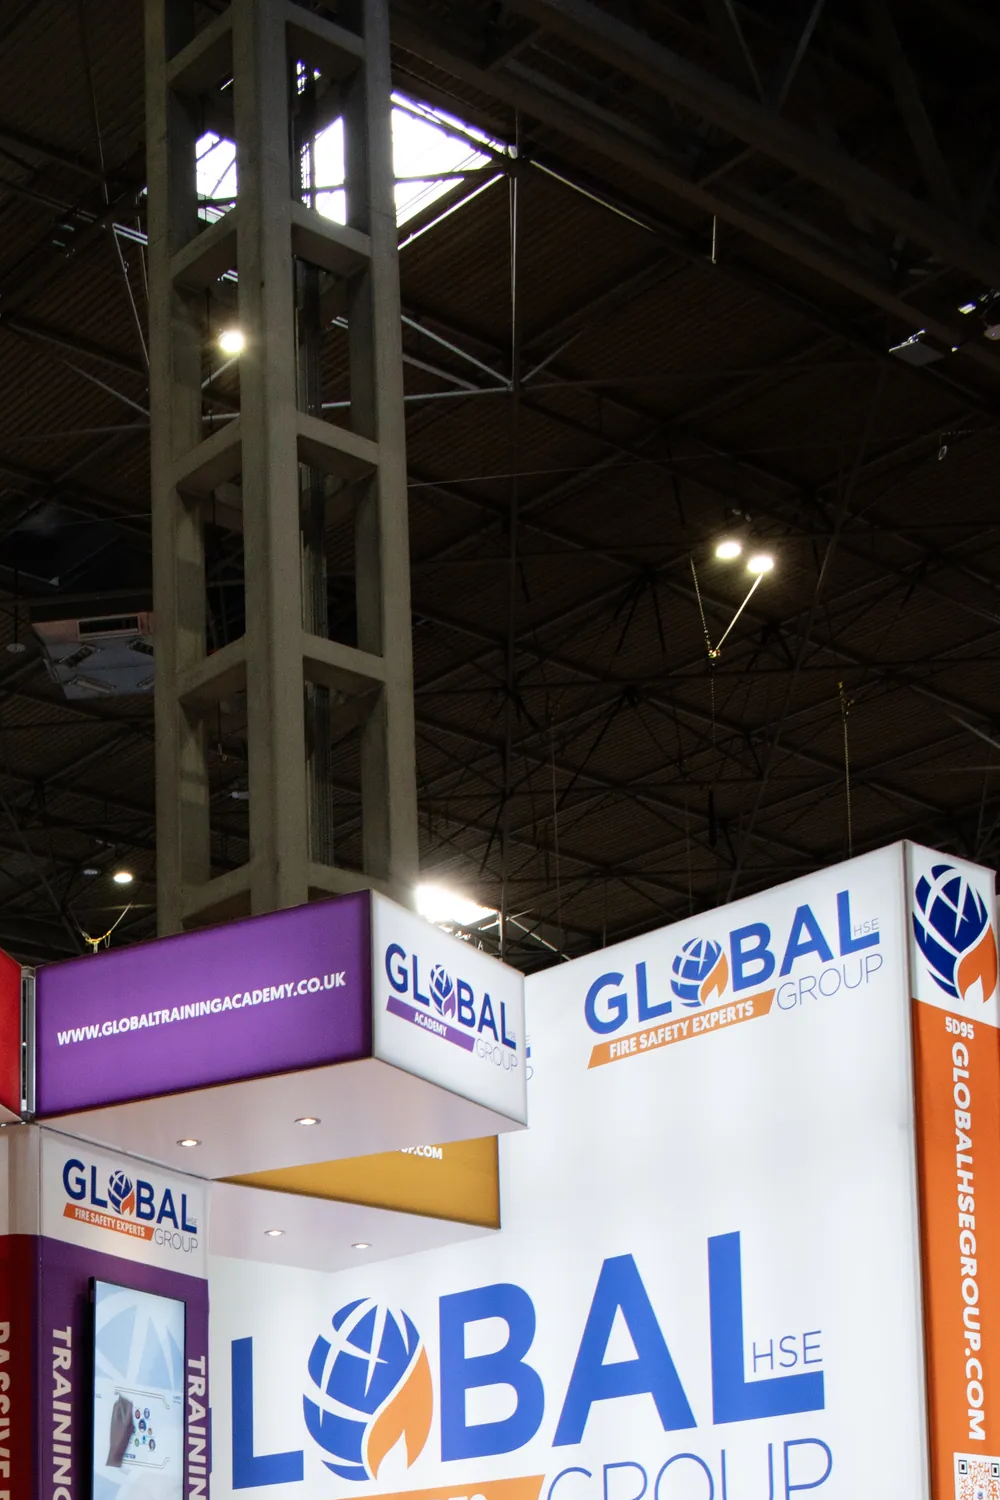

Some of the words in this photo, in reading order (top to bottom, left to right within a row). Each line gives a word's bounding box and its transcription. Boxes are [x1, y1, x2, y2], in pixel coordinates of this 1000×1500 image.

[853, 918, 880, 937] HSE
[584, 890, 881, 1035] GLOBAL
[776, 953, 884, 1011] GROUP
[57, 971, 346, 1046] WWW.GLOBALTRAININGACADEMY.CO.UK
[385, 943, 517, 1050] GLOBAL
[414, 1012, 448, 1037] ACADEMY
[609, 1036, 637, 1059] FIRE
[639, 1018, 689, 1049] SAFETY
[692, 1001, 755, 1035] EXPERTS
[945, 1016, 974, 1040] 5D95
[475, 1038, 518, 1073] GROUP
[63, 1159, 198, 1234] GLOBAL
[75, 1208, 90, 1222] FIRE
[90, 1213, 116, 1228] SAFETY
[117, 1220, 145, 1237] EXPERTS
[154, 1228, 199, 1254] GROUP
[952, 1041, 986, 1441] GLOBALHSEGROUP.COM
[751, 1330, 823, 1373] HSE
